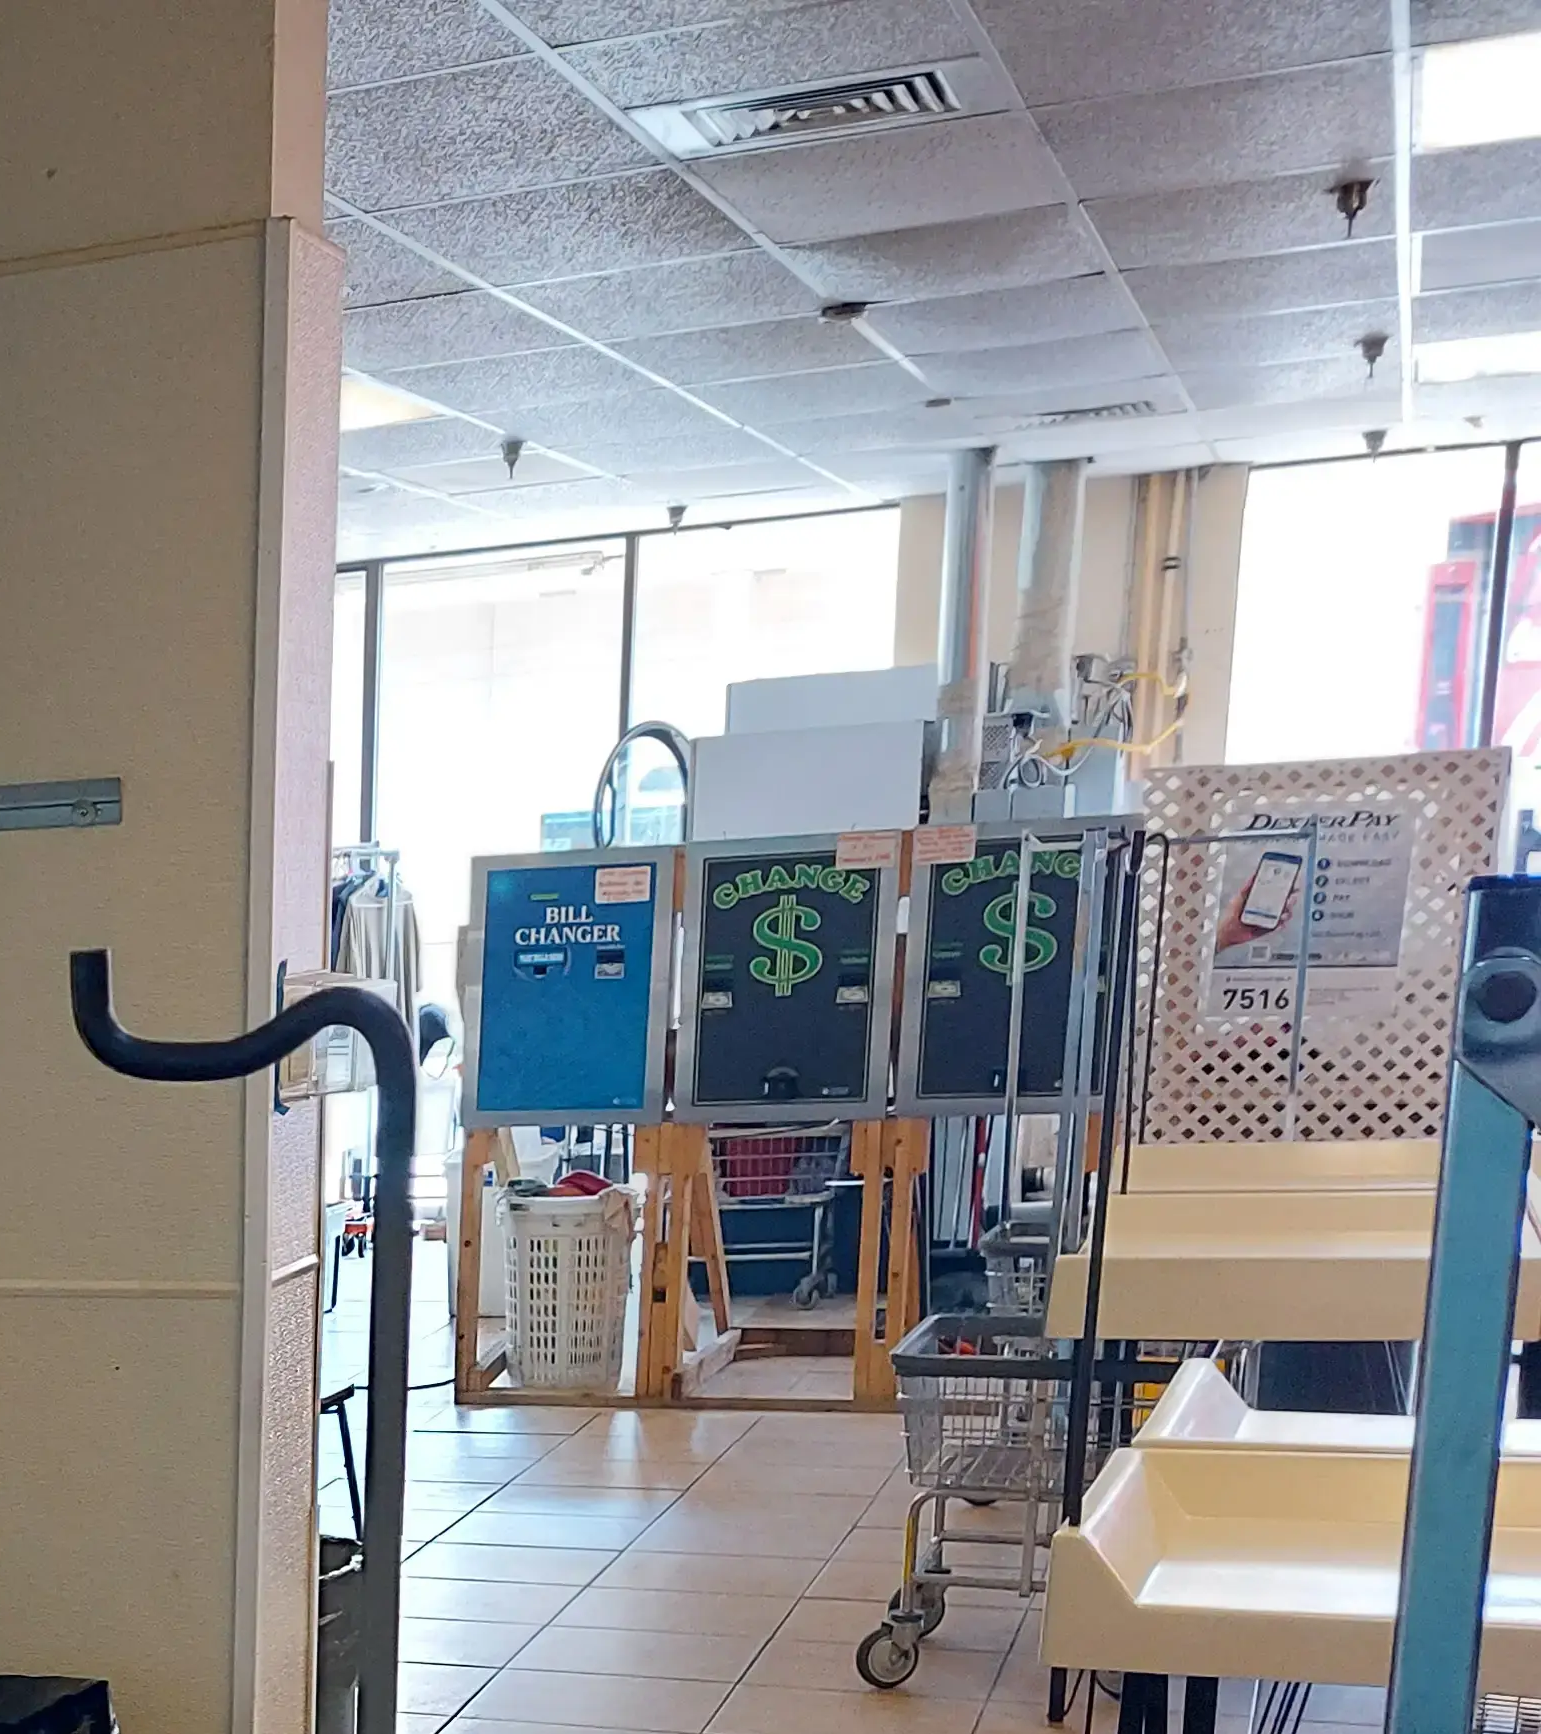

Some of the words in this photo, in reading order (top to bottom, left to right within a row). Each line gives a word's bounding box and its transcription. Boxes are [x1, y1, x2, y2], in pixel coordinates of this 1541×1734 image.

[941, 850, 1081, 896] CHANG
[713, 864, 870, 909] CHANGE
[545, 905, 594, 924] BILL
[515, 925, 620, 946] CHANGER
[1223, 988, 1289, 1010] 7516
